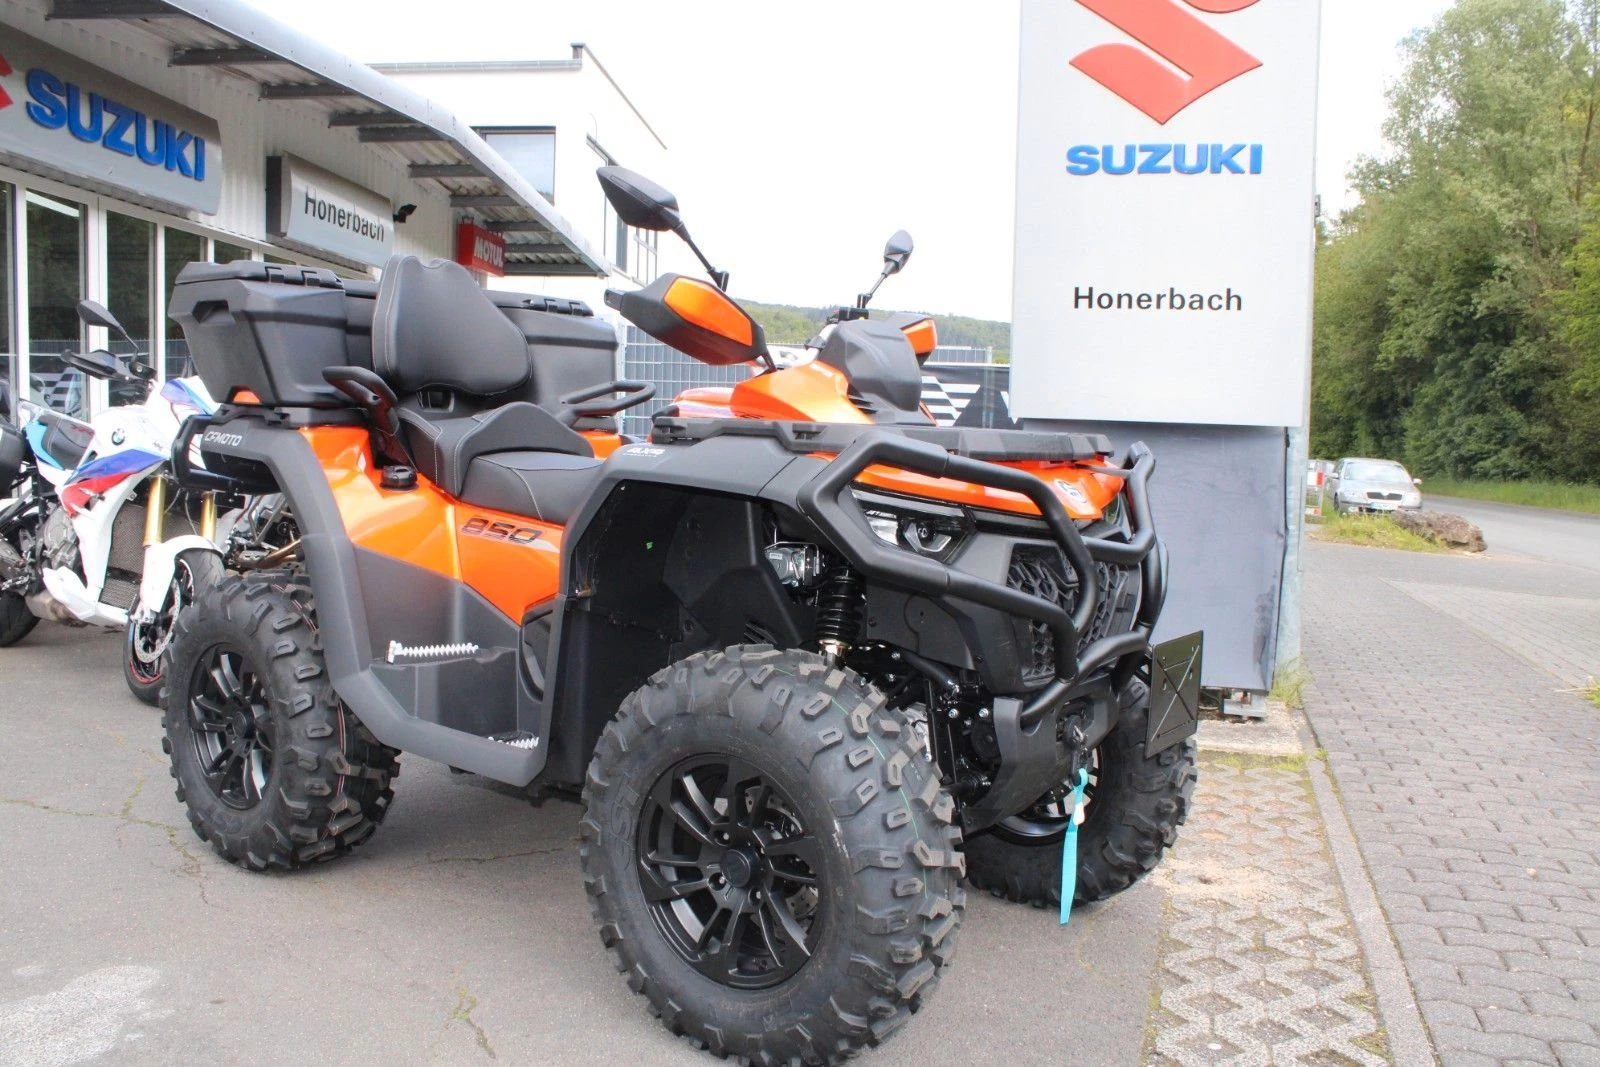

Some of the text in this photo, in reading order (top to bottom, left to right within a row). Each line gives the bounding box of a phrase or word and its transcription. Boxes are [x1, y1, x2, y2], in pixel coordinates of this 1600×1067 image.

[26, 68, 205, 182] SUZUKI
[1066, 144, 1263, 175] SUZUKI
[305, 186, 384, 242] Honerbach
[1074, 287, 1242, 311] Honerbach
[204, 430, 243, 447] CFMOTO
[462, 517, 543, 544] 850
